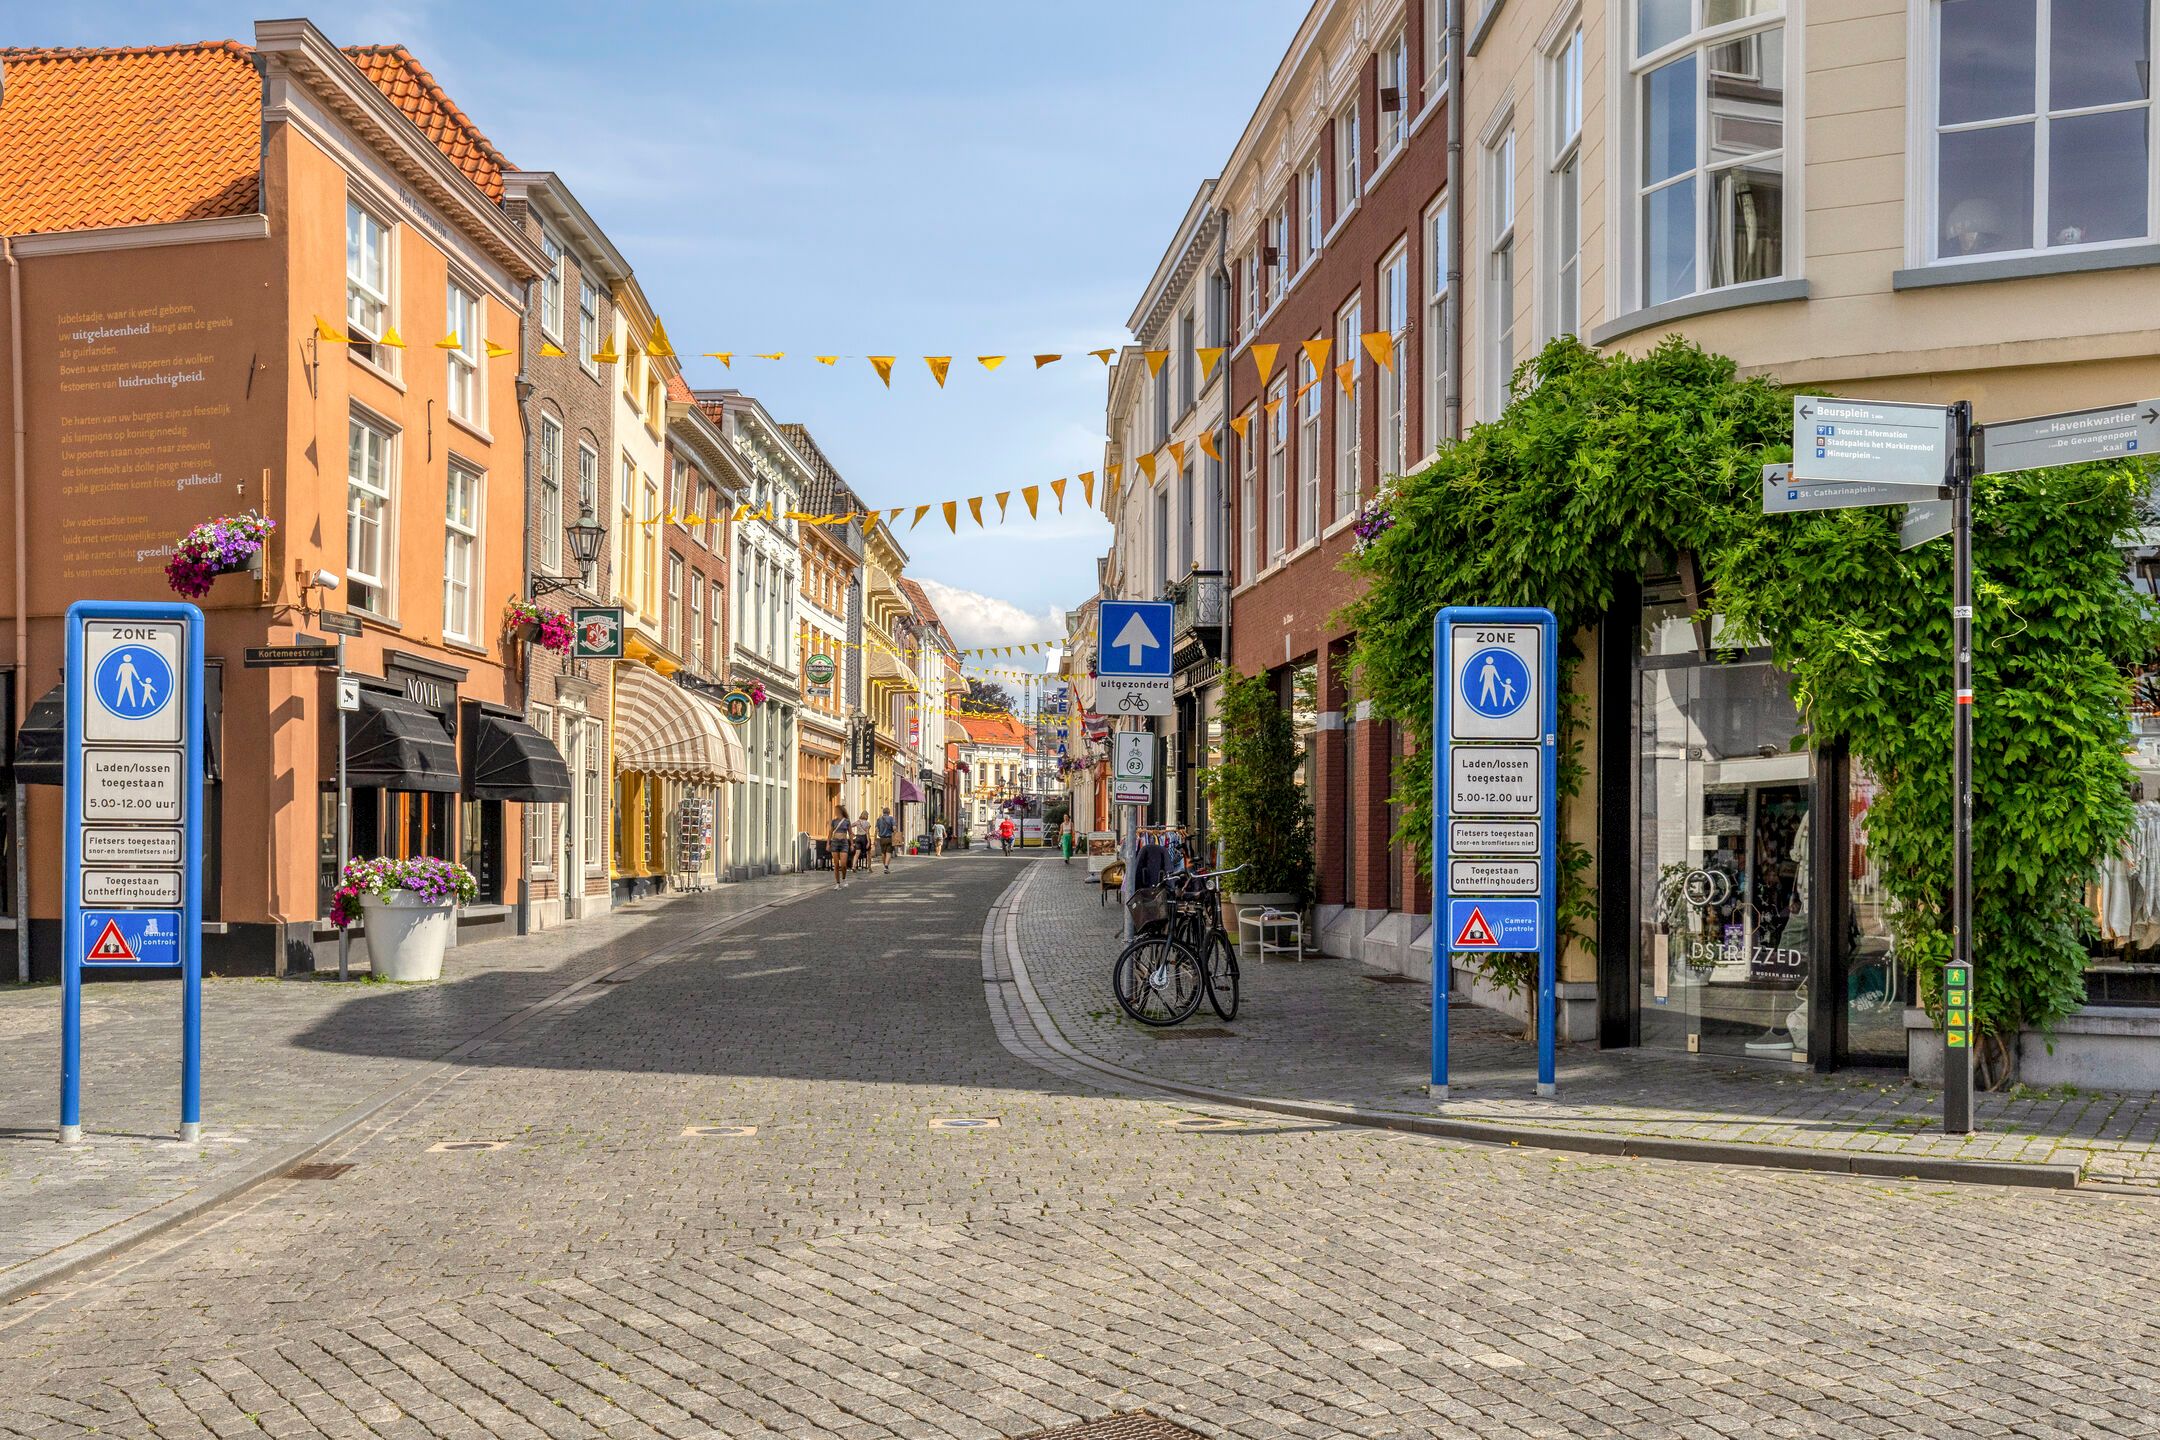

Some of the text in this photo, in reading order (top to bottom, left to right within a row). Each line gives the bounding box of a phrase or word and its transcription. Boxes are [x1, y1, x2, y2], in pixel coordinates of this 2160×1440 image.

[107, 311, 126, 320] waar
[129, 307, 137, 318] ik
[138, 306, 157, 317] werd
[159, 304, 195, 318] geboren,
[59, 316, 233, 343] uw uitgelatenheid hangt aan de gevels
[59, 347, 71, 358] als
[60, 353, 214, 375] Boven uw straten wapperen de wolken
[60, 370, 205, 392] festoenen van luidruchtigheid.
[61, 404, 231, 426] De harten van uw burgers zijn zo feestelijk
[1817, 406, 1869, 419] Beursplein
[2051, 412, 2136, 432] Havenkwartier
[61, 432, 73, 444] als
[74, 431, 112, 444] lampions
[114, 431, 125, 442] op
[1838, 428, 1863, 436] Tourist
[1864, 429, 1908, 439] Information
[2057, 439, 2068, 447] De
[2071, 430, 2137, 445] Gevangenpoort
[61, 440, 211, 462] Uw poorten staan open naar zeewind
[1827, 439, 1934, 452] Stadspaleis het Markiezenhof
[2103, 443, 2123, 452] Kaai
[1827, 450, 1870, 460] Mineurplein
[61, 466, 74, 477] die
[121, 463, 133, 473] als
[134, 461, 154, 472] dolle
[156, 460, 179, 473] jonge
[62, 473, 222, 496] op alle gezichten komt frisse gulheid!
[1800, 490, 1812, 498] St.
[1814, 485, 1876, 497] Catharinaplein
[63, 519, 76, 528] Uw
[82, 534, 98, 543] met
[100, 531, 156, 543] vertrouwelijke
[75, 550, 90, 560] alle
[63, 568, 74, 578] als
[76, 568, 90, 577] van
[92, 566, 127, 577] moeders
[112, 628, 156, 640] ZONE
[1476, 632, 1516, 643] ZONE
[258, 649, 323, 658] Kortemeestraat
[1101, 680, 1169, 690] uitgezonderd
[407, 678, 440, 708] NOVIA
[96, 763, 170, 773] Laden/lossen
[1129, 762, 1140, 770] 83
[1462, 760, 1528, 768] Laden/lossen
[102, 778, 164, 790] toegestaan
[1467, 774, 1523, 784] toegestaan
[1457, 793, 1512, 802] 5.00-12.00
[90, 799, 152, 808] 5.00-12.00
[1490, 830, 1534, 839] toegestaan
[89, 837, 176, 846] Fietsers toegestaan
[1471, 867, 1518, 876] Toegestaan
[105, 877, 159, 886] Toegestaan
[1455, 877, 1534, 886] ontheffinghouders
[87, 888, 177, 898] ontheffinghouders
